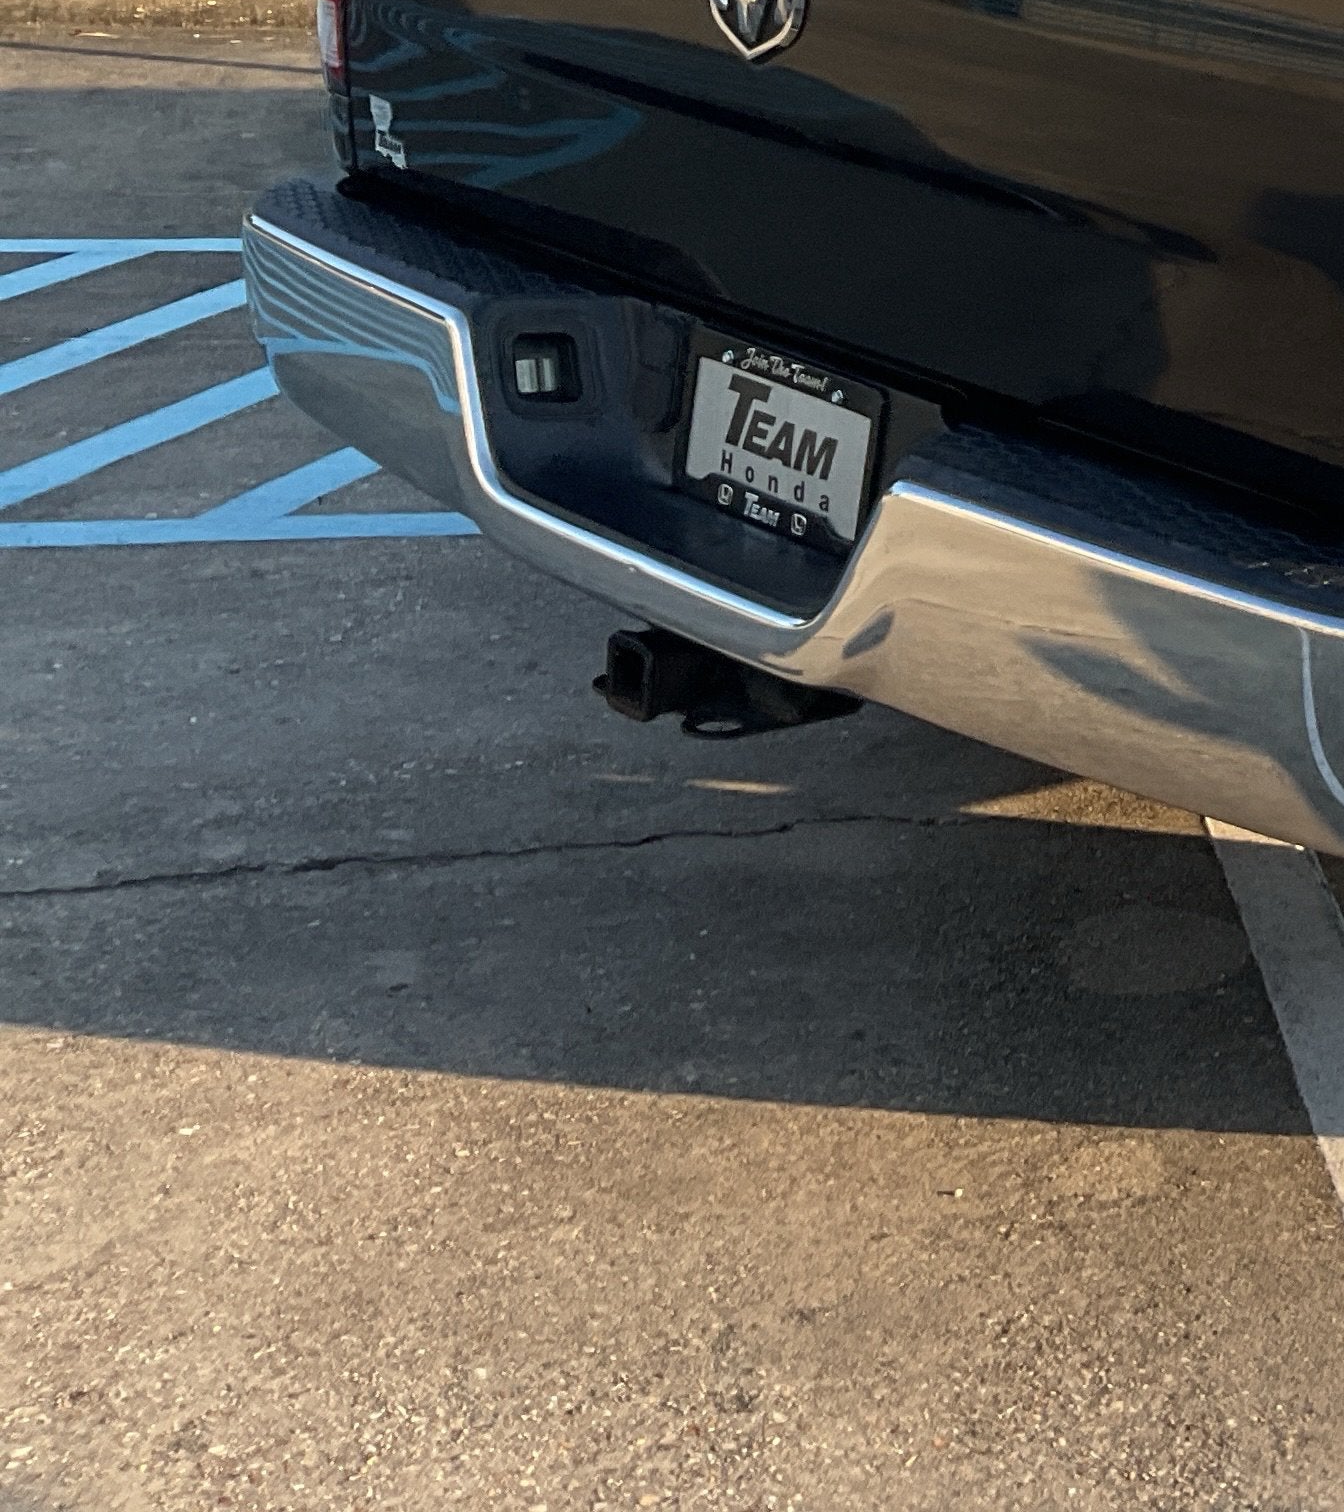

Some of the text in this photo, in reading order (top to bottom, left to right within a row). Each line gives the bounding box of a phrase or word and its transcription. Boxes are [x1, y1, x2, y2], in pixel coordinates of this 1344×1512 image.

[725, 373, 839, 482] TEAM
[720, 449, 830, 514] Honda
[744, 491, 781, 528] TEAM
